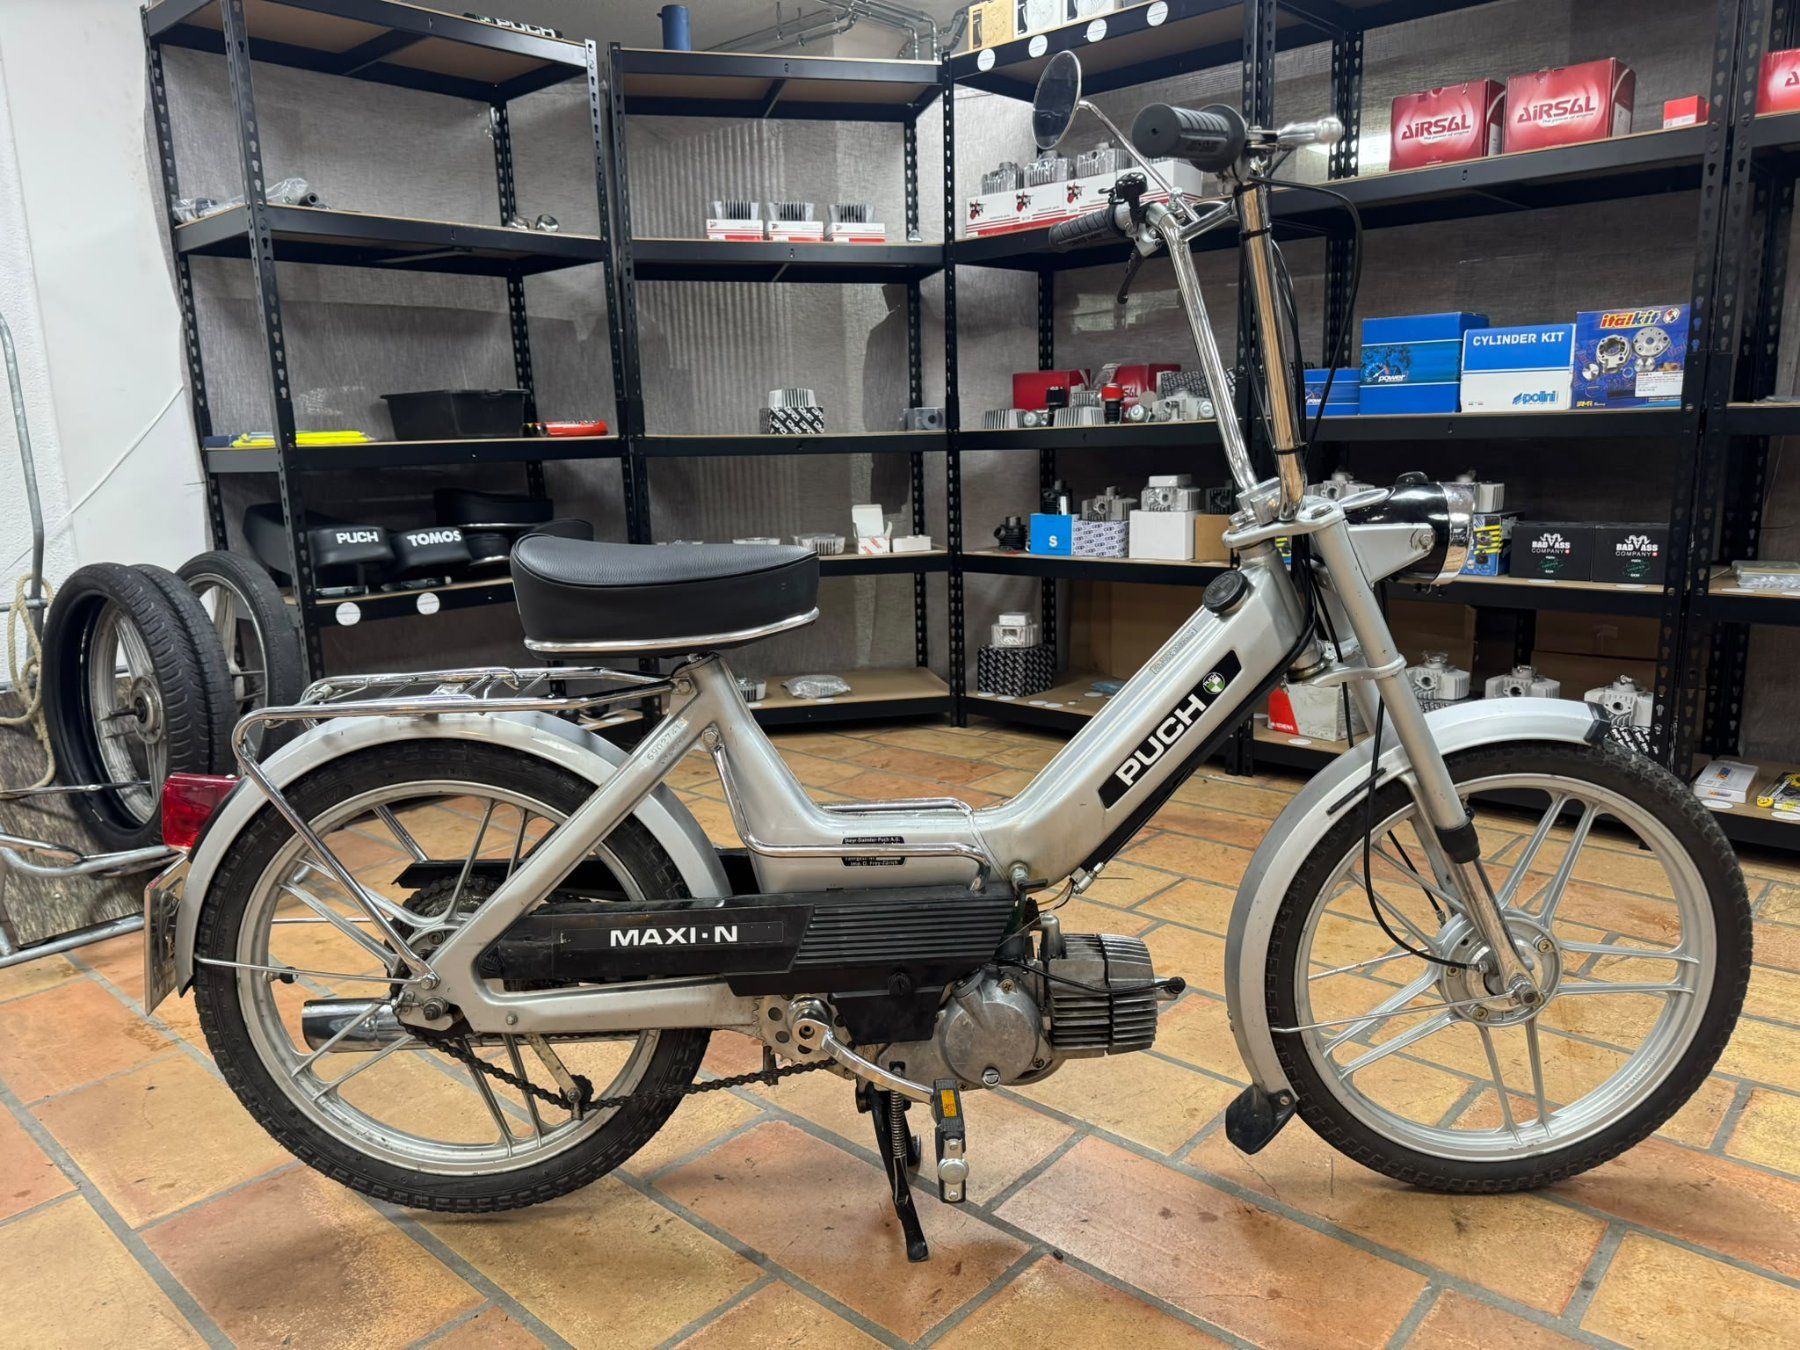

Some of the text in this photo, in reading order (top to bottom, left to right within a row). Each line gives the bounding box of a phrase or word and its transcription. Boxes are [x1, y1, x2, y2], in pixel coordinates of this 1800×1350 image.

[1472, 331, 1565, 347] CYLINDER KIT
[1522, 390, 1557, 405] polini
[336, 531, 379, 544] PUCH
[406, 530, 462, 547] TOMOS
[1048, 535, 1058, 548] S
[1554, 541, 1571, 549] ASS
[1616, 543, 1634, 551] BAD
[1115, 693, 1207, 787] PUCH
